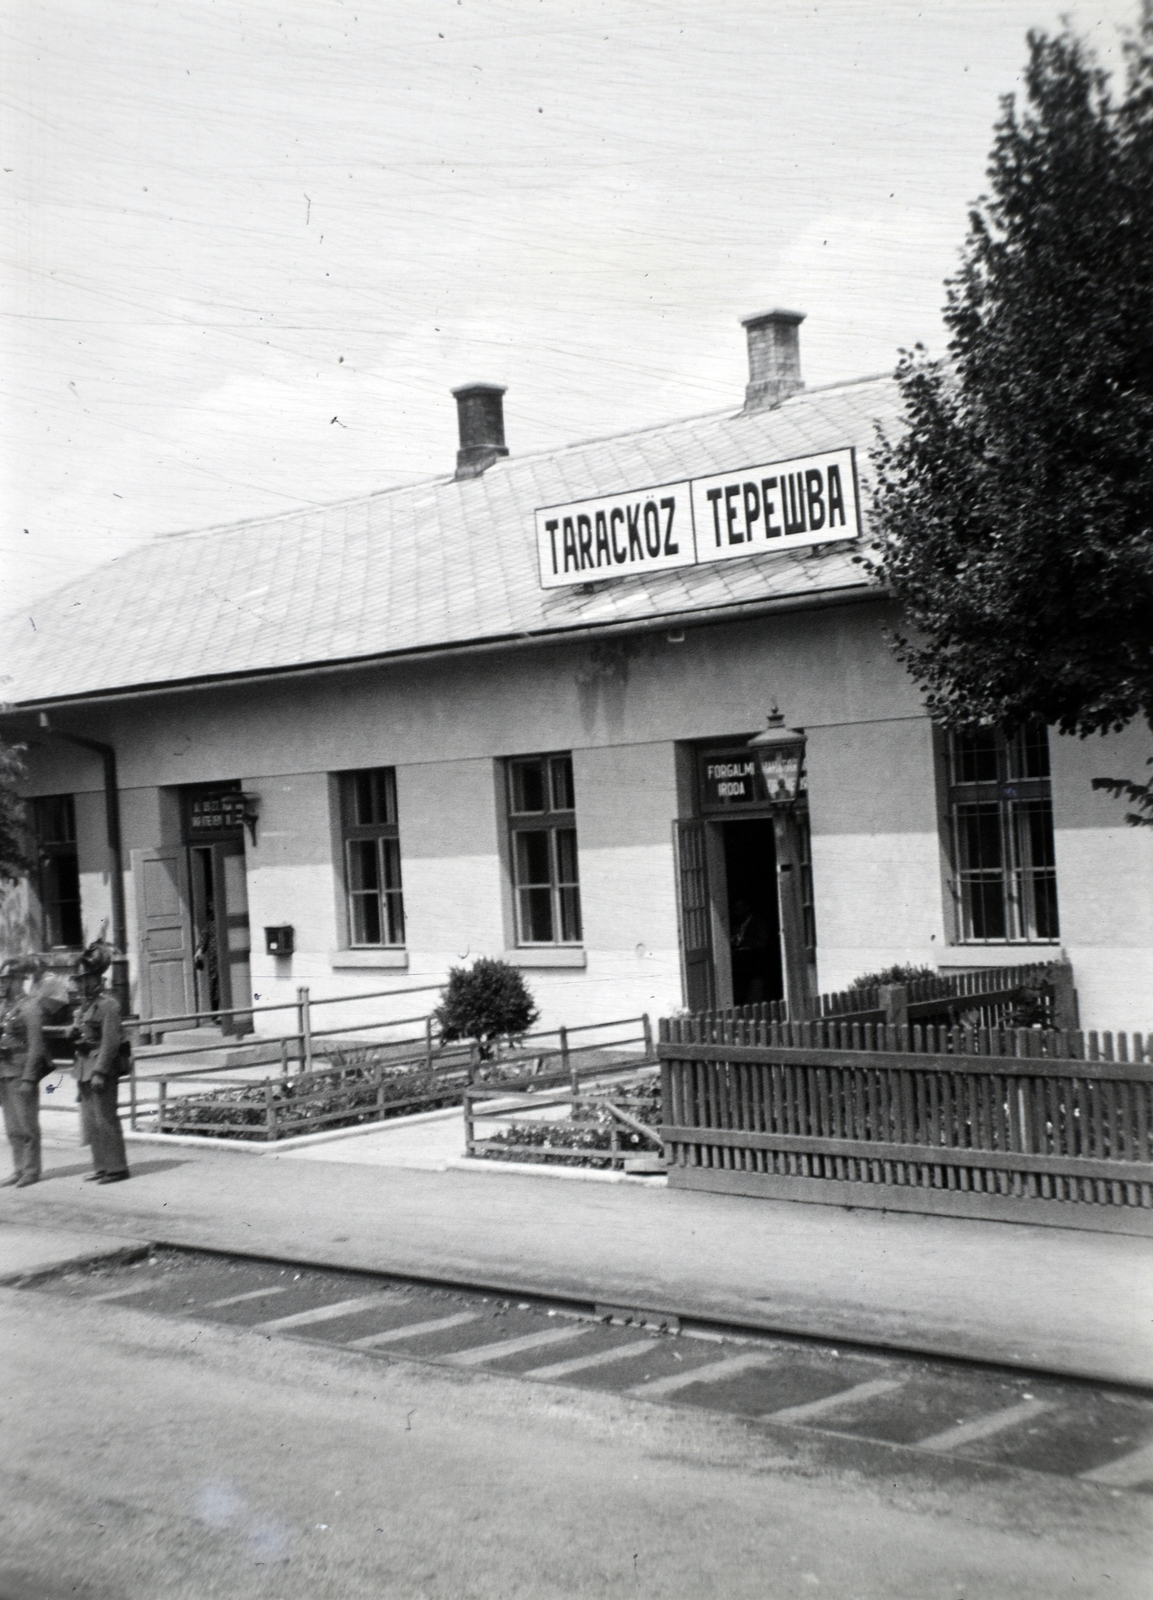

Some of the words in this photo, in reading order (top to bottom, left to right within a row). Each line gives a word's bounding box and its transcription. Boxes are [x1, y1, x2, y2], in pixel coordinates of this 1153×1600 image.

[706, 464, 847, 547] ТЕРЕШВА
[545, 495, 679, 574] TARACKÖZ
[707, 761, 755, 779] FORGALMI
[718, 781, 745, 797] IRODA
